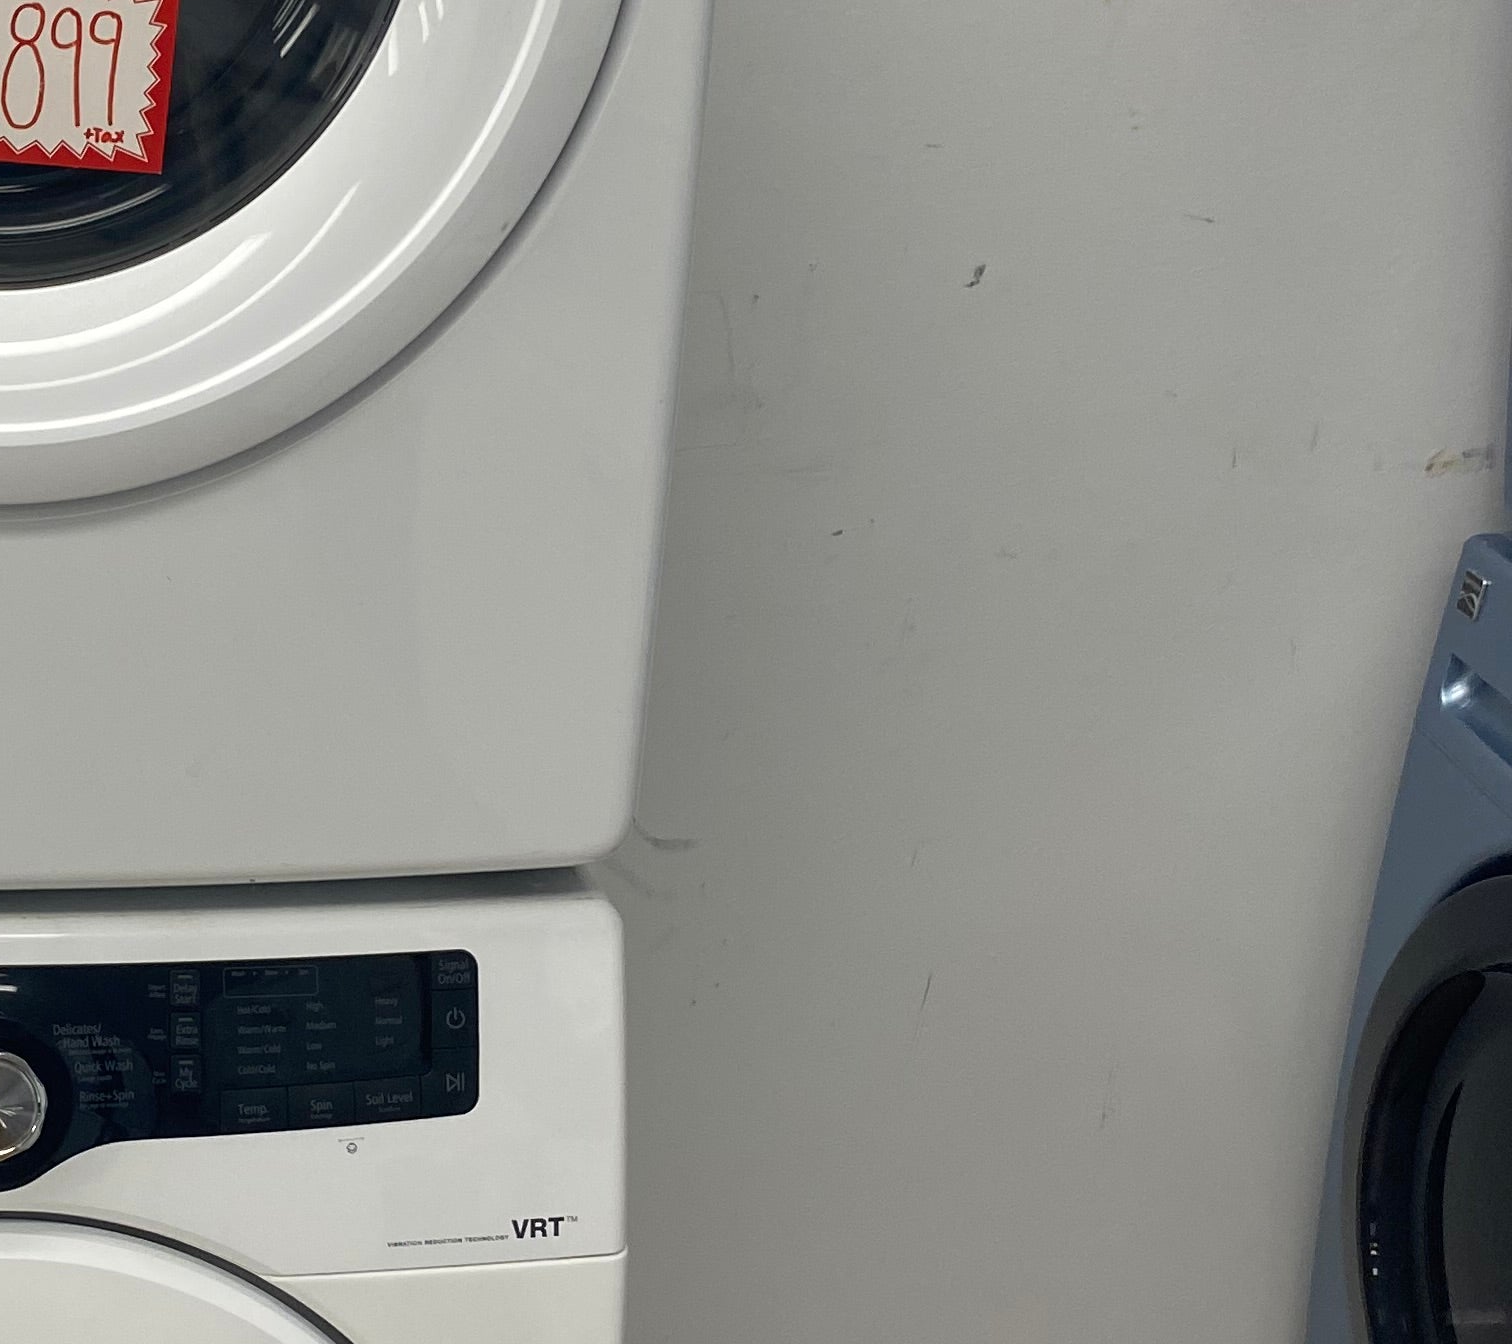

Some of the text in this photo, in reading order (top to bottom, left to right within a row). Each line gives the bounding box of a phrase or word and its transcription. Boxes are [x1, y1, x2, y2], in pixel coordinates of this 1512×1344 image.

[439, 959, 469, 972] Signal
[62, 1035, 121, 1049] Hand Wash
[74, 1059, 134, 1074] Quick Wash
[310, 1099, 333, 1112] Spin
[365, 1091, 414, 1106] Soil Level
[511, 1216, 565, 1239] VRT
